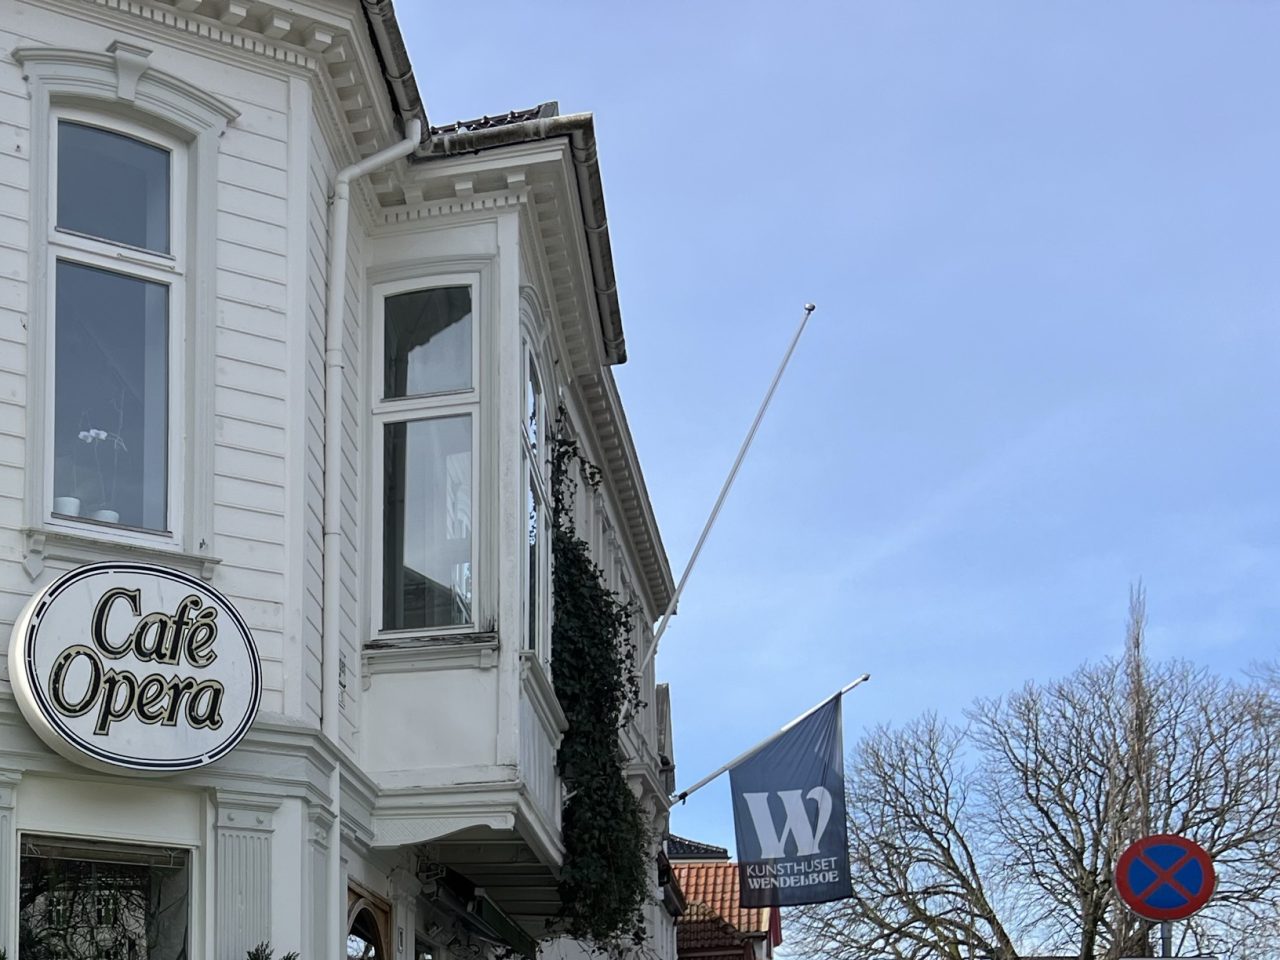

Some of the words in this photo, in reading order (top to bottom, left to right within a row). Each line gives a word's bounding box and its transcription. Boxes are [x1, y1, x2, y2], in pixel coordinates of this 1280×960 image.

[91, 587, 218, 668] Café
[48, 644, 224, 736] Opera
[743, 786, 833, 859] W
[746, 857, 838, 877] KUNSTHUSET
[748, 870, 839, 889] WENDELBOE
